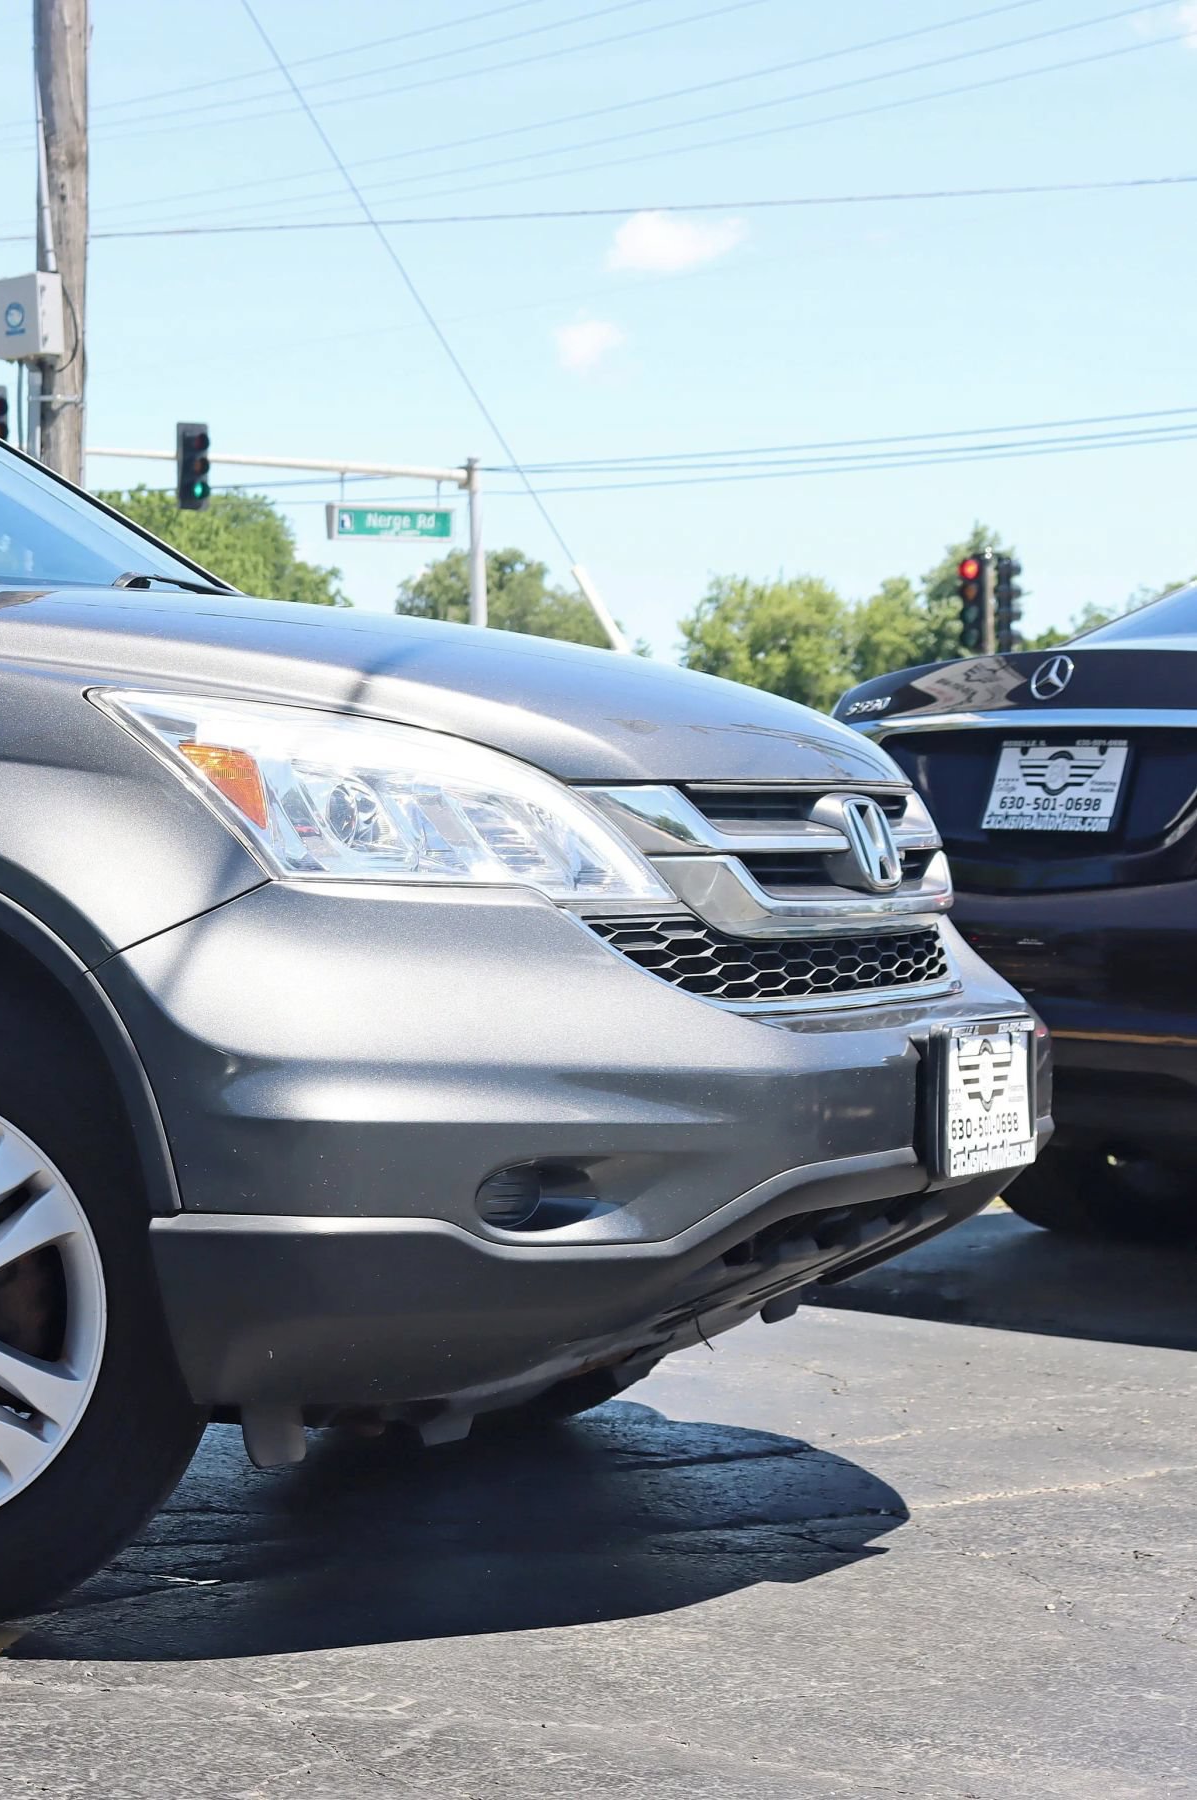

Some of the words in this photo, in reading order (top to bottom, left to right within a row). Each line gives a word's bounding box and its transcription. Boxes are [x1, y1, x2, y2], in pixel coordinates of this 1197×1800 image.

[365, 511, 411, 530] Nerge
[415, 513, 436, 529] Rd
[999, 796, 1102, 811] 630-501-0698
[951, 1112, 1019, 1140] 630-501-0698
